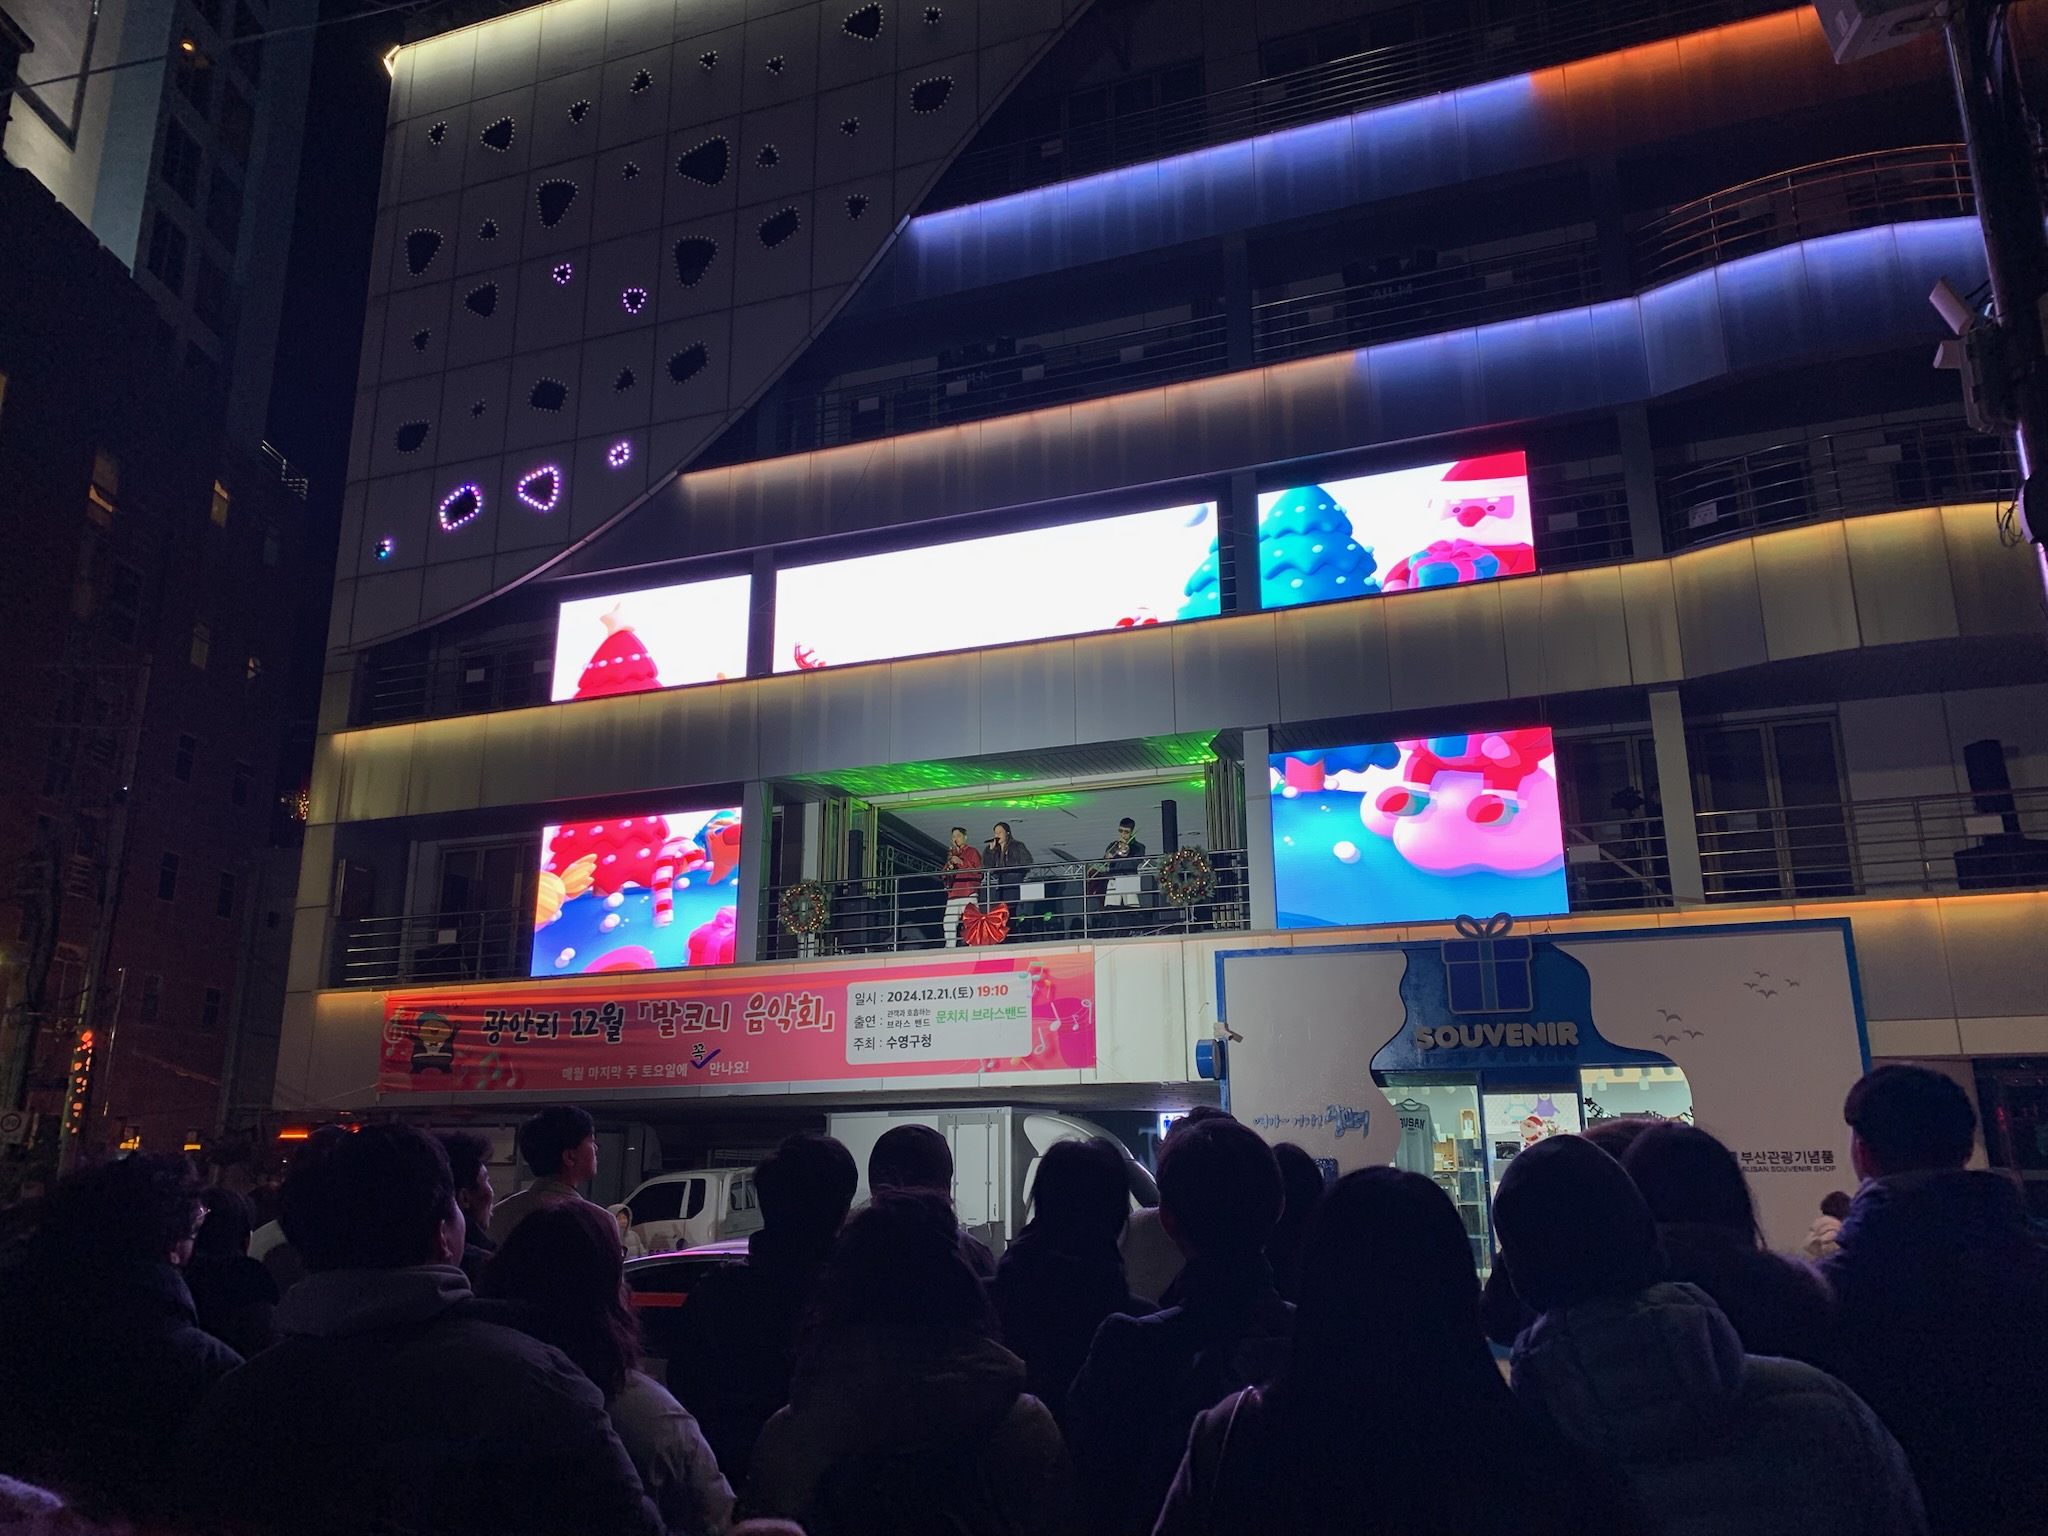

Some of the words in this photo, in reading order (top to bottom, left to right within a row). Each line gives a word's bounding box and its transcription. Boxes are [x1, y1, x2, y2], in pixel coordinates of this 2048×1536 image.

[854, 991, 876, 1006] 일시
[887, 986, 974, 1003] 2024.12.21.(토)
[977, 984, 1009, 997] 19:10
[481, 1008, 560, 1046] 광안리
[570, 1001, 625, 1044] 12월
[853, 1015, 876, 1029] 출연
[886, 1020, 911, 1029] 브라스
[914, 1018, 931, 1028] 밴드
[935, 1010, 968, 1024] 문치치
[971, 1006, 1028, 1021] 브라스밴드
[853, 1036, 876, 1051] 주최
[886, 1034, 932, 1049] 수영구청
[1416, 1021, 1580, 1049] SOUVENIR
[691, 1043, 706, 1061] 꼭
[562, 1066, 584, 1081] 매월
[588, 1065, 622, 1081] 마지막
[626, 1065, 638, 1080] 주
[641, 1063, 688, 1078] 토요일에
[709, 1061, 749, 1076] 만나요!
[1741, 1150, 1835, 1165] 부산관광기념품
[1771, 1165, 1812, 1173] SOUVENIR
[1814, 1165, 1837, 1173] SHOP
